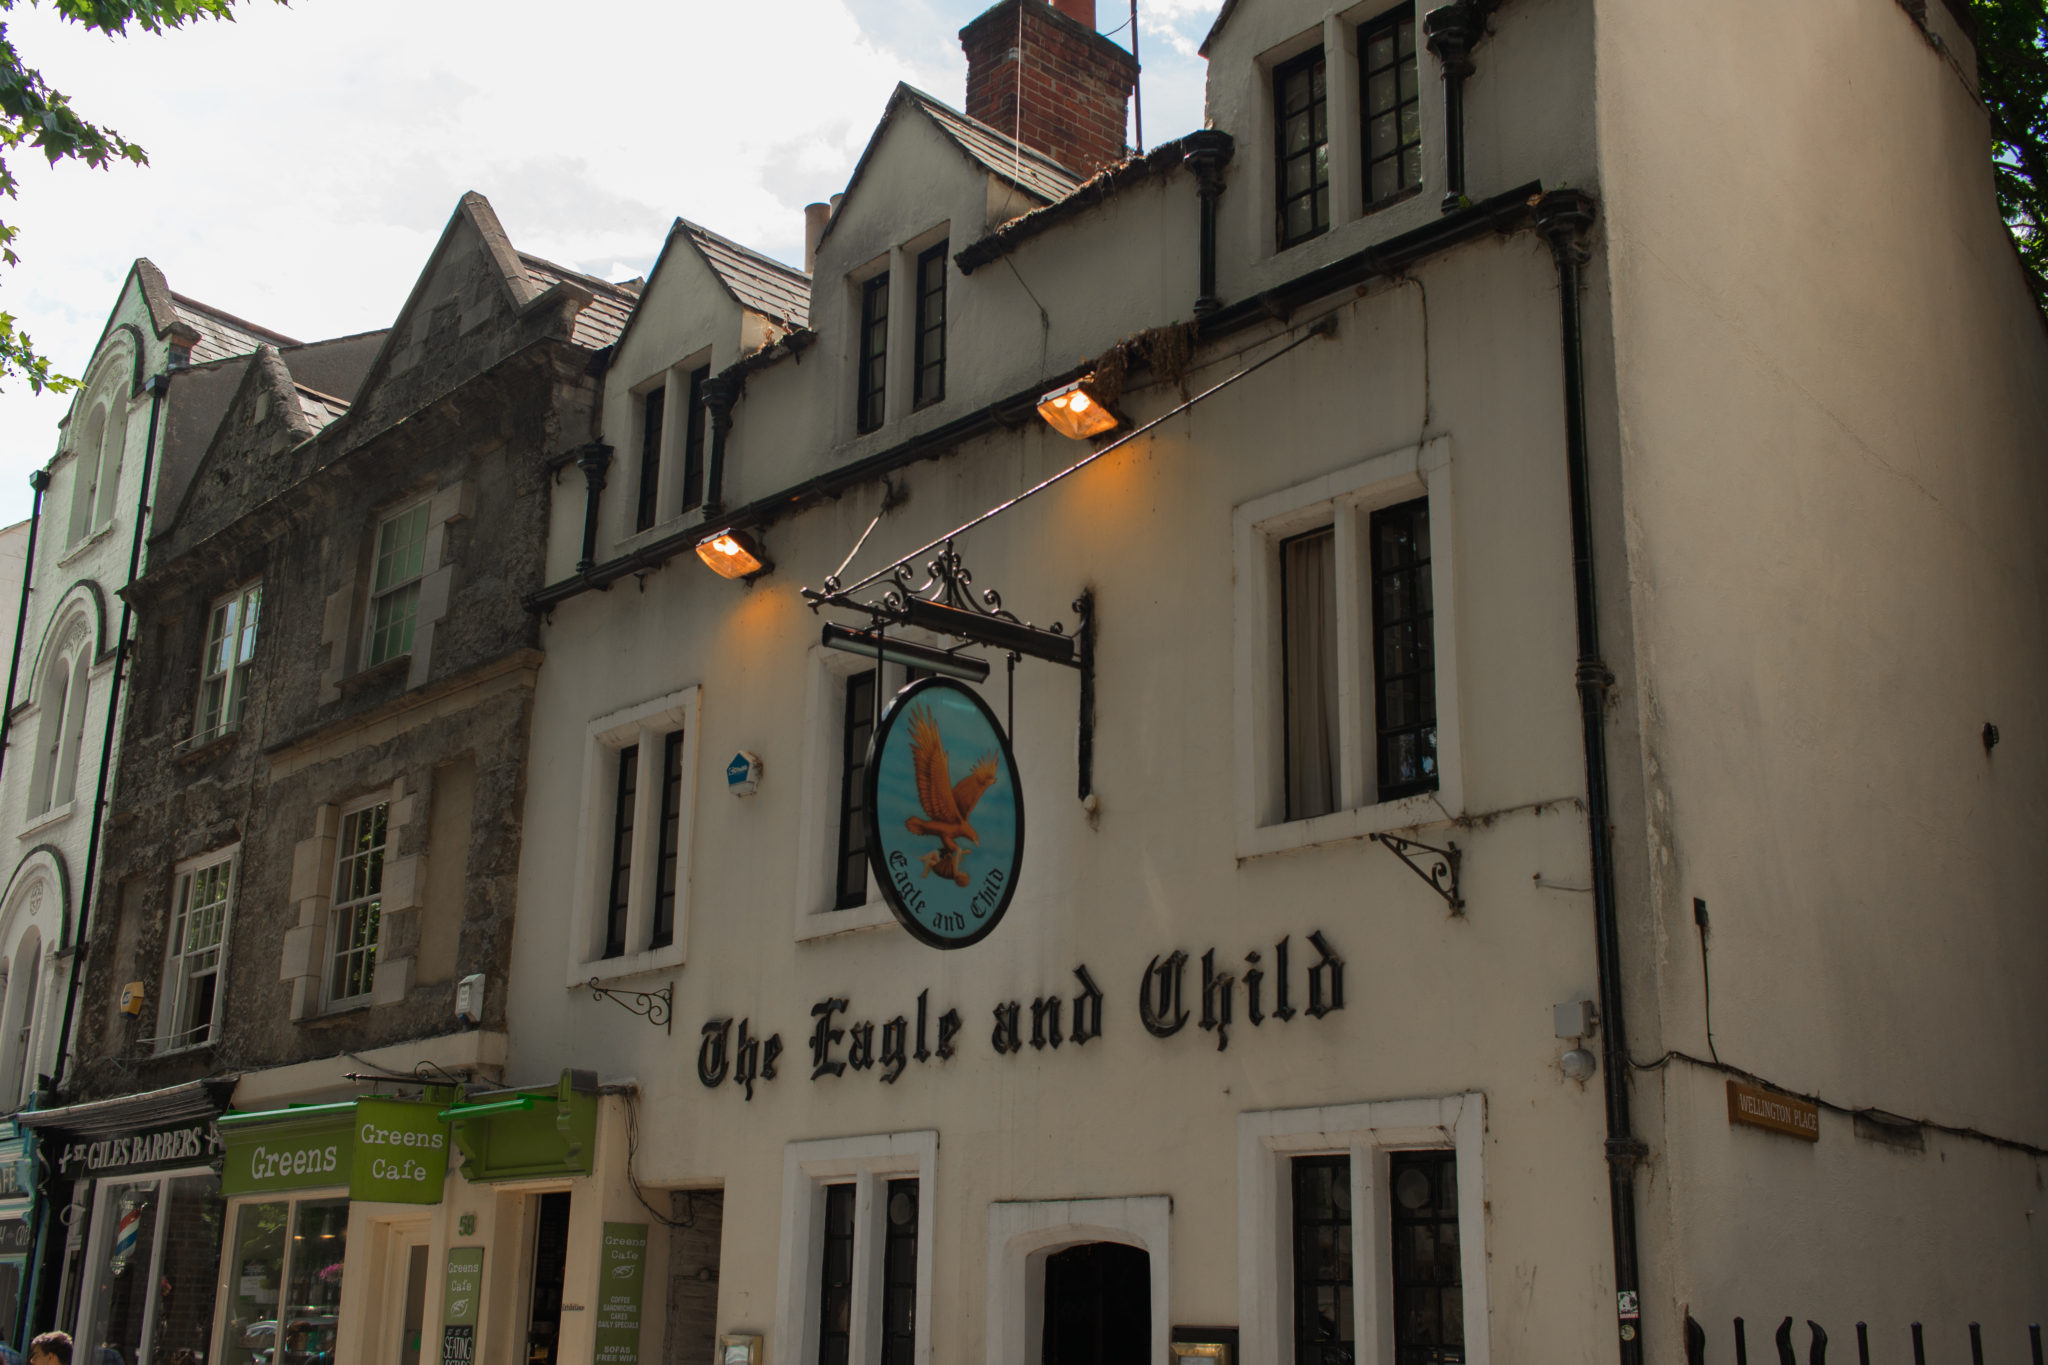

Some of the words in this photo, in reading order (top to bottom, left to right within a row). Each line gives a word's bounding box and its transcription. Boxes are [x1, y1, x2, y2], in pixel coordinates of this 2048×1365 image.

[889, 850, 926, 914] Eagle
[932, 911, 965, 932] and
[970, 868, 1004, 919] Child
[697, 1017, 784, 1101] The
[809, 987, 962, 1085] Eagle
[991, 963, 1104, 1054] and
[1139, 930, 1345, 1051] Child
[1739, 1094, 1792, 1124] WELLINGTON
[1794, 1109, 1817, 1131] PLACE
[87, 1137, 130, 1170] GILES
[130, 1126, 202, 1164] BARBERS
[360, 1123, 444, 1149] Greens
[251, 1145, 338, 1180] Greens
[372, 1158, 427, 1182] Cafe
[458, 1215, 475, 1236] 50
[605, 1235, 646, 1247] Greens
[611, 1249, 639, 1260] Cafe
[447, 1262, 479, 1274] Greens
[450, 1280, 472, 1292] Cafe
[443, 1335, 472, 1360] SEATING
[596, 1353, 617, 1362] FREE
[603, 1345, 631, 1354] SOFAS
